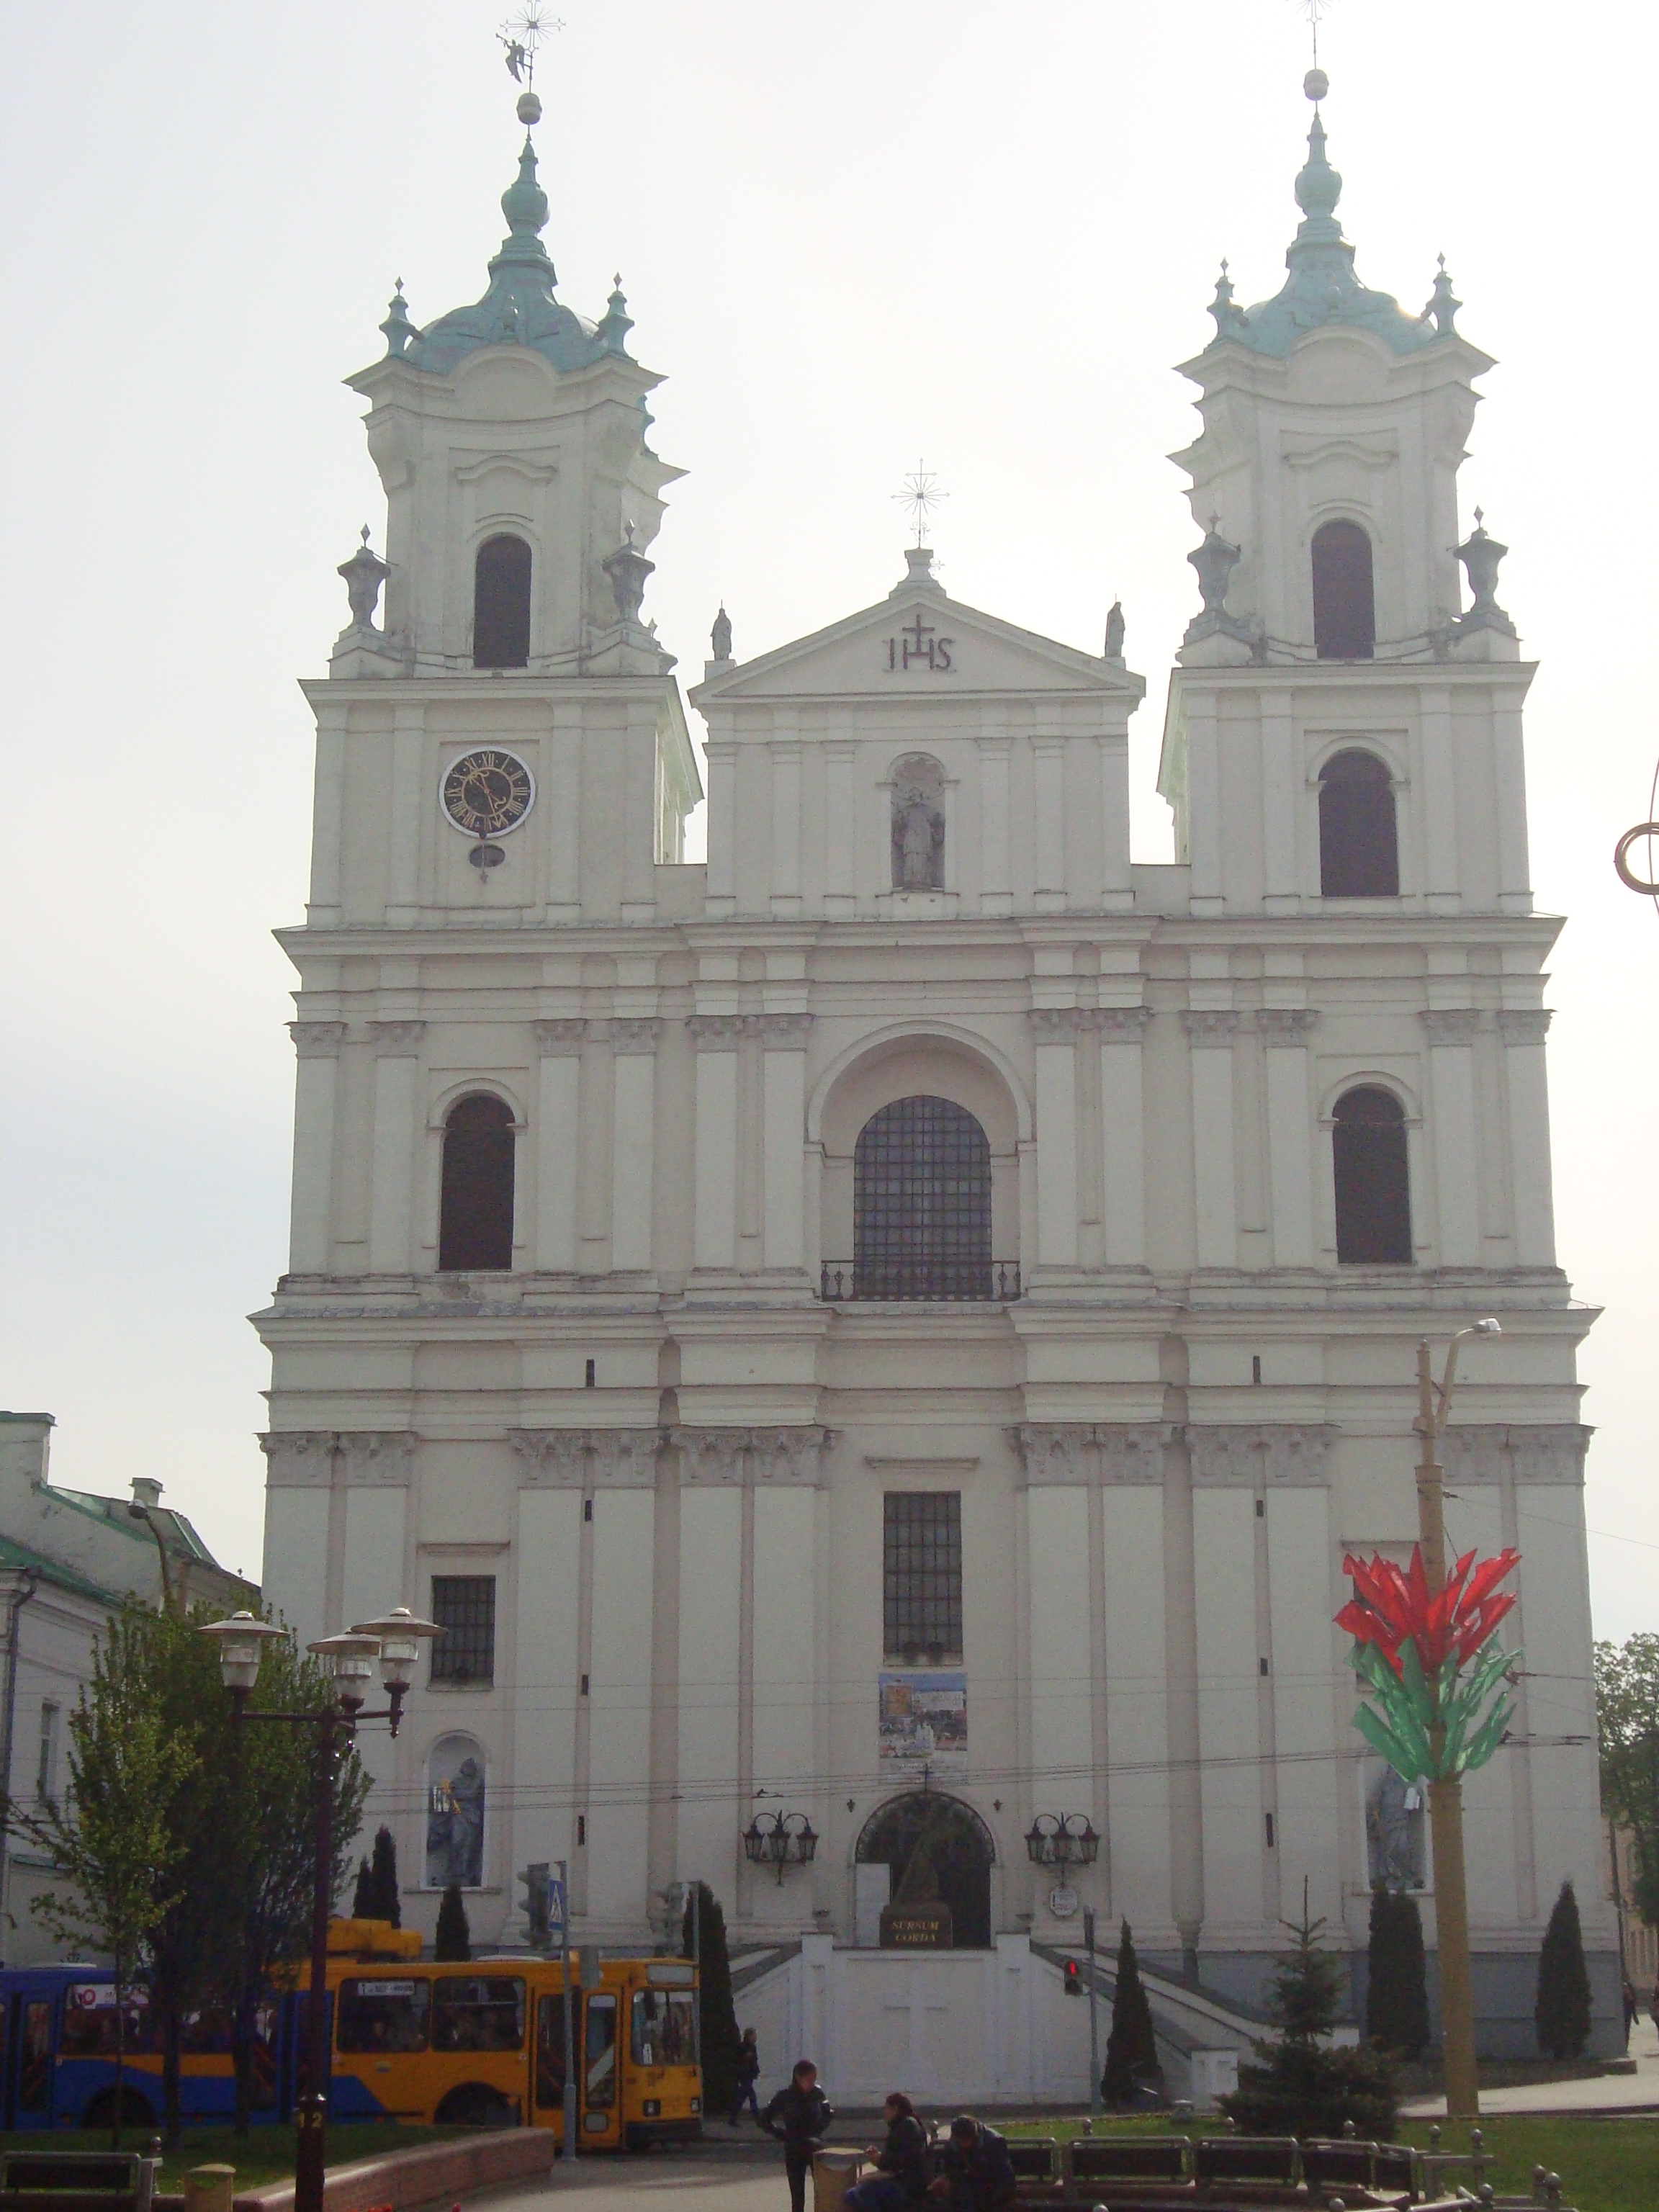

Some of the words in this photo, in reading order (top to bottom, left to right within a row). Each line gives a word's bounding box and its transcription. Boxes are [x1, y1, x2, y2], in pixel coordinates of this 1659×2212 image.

[882, 637, 956, 673] IHS
[892, 1920, 940, 1930] SURSUM
[895, 1933, 937, 1943] CORDA
